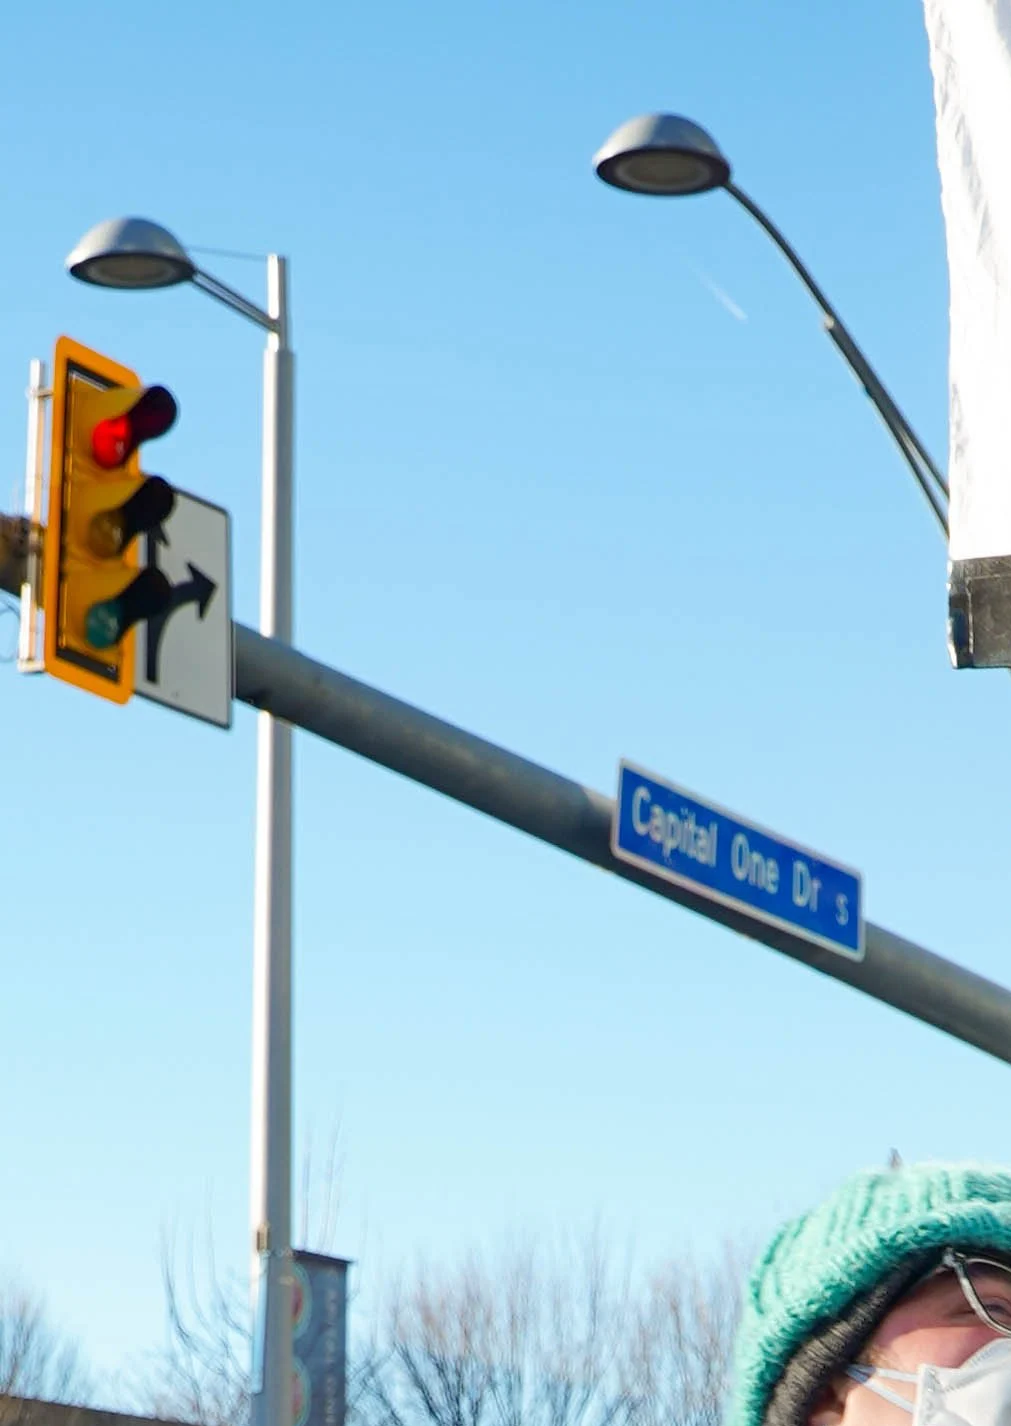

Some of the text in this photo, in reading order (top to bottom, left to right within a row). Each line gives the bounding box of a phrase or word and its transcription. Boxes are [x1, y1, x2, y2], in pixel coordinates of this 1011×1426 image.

[632, 786, 718, 867] Capital
[731, 833, 779, 895] One
[792, 860, 822, 912] Dr
